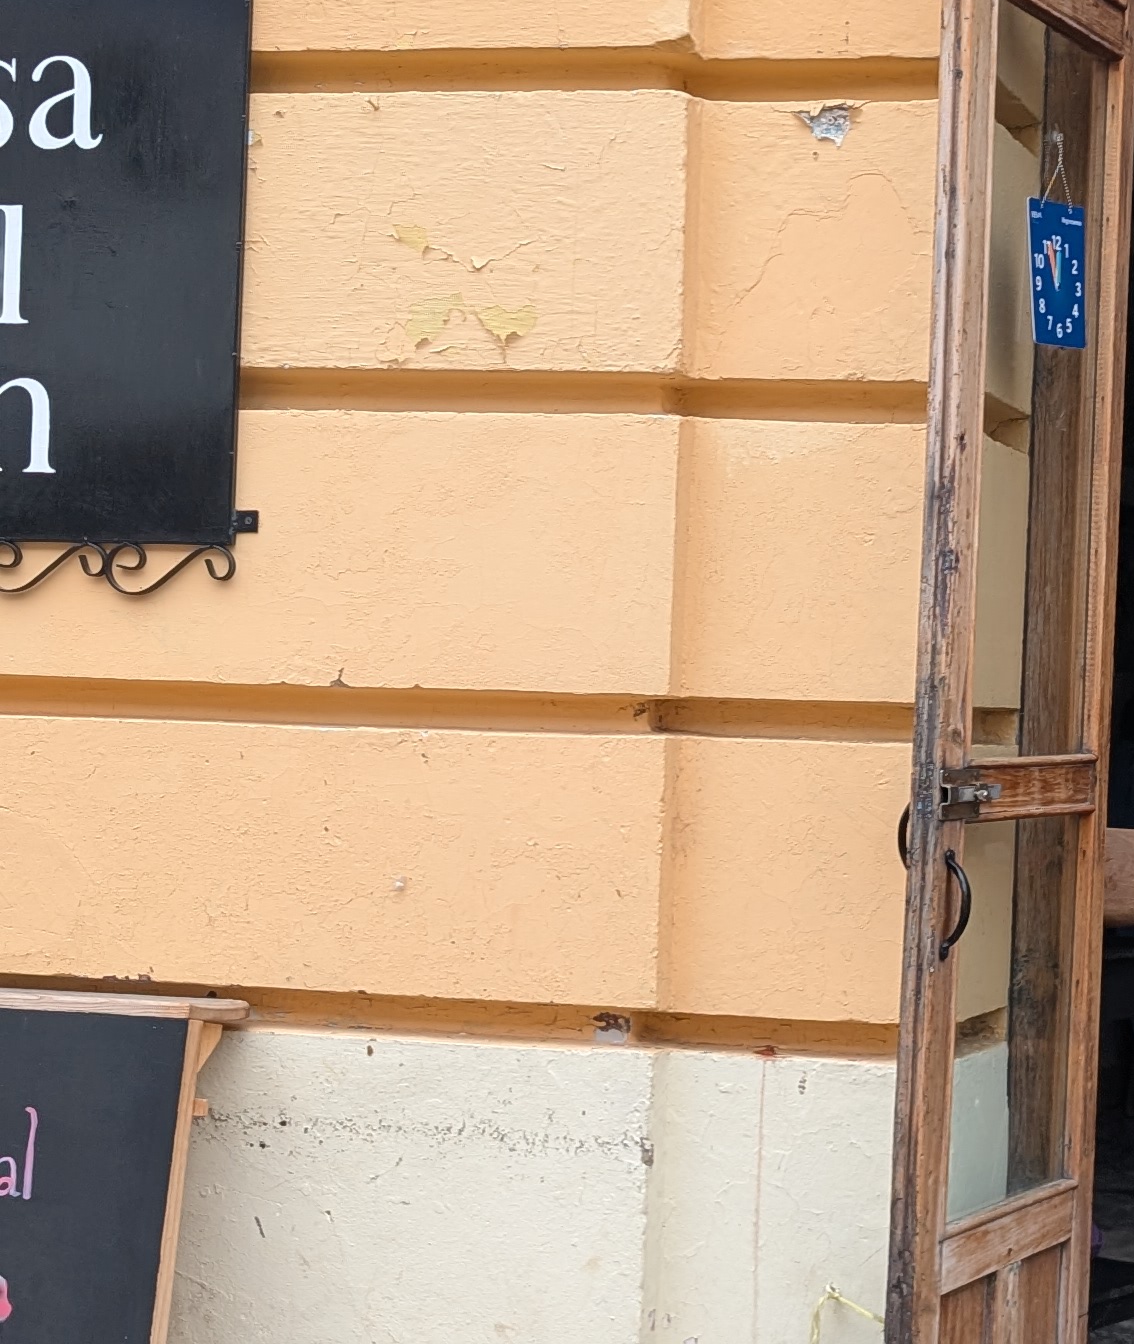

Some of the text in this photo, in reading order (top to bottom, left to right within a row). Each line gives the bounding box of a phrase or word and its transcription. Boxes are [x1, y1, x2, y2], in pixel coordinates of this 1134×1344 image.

[1064, 244, 1070, 259] 1
[1034, 254, 1045, 270] 10
[1071, 260, 1079, 275] 2
[1036, 276, 1043, 292] 9
[1075, 282, 1082, 298] 3
[1039, 298, 1047, 314] 8
[1072, 304, 1080, 319] 4
[1047, 316, 1054, 331] 7
[1056, 323, 1063, 339] 6
[1066, 318, 1073, 334] 5
